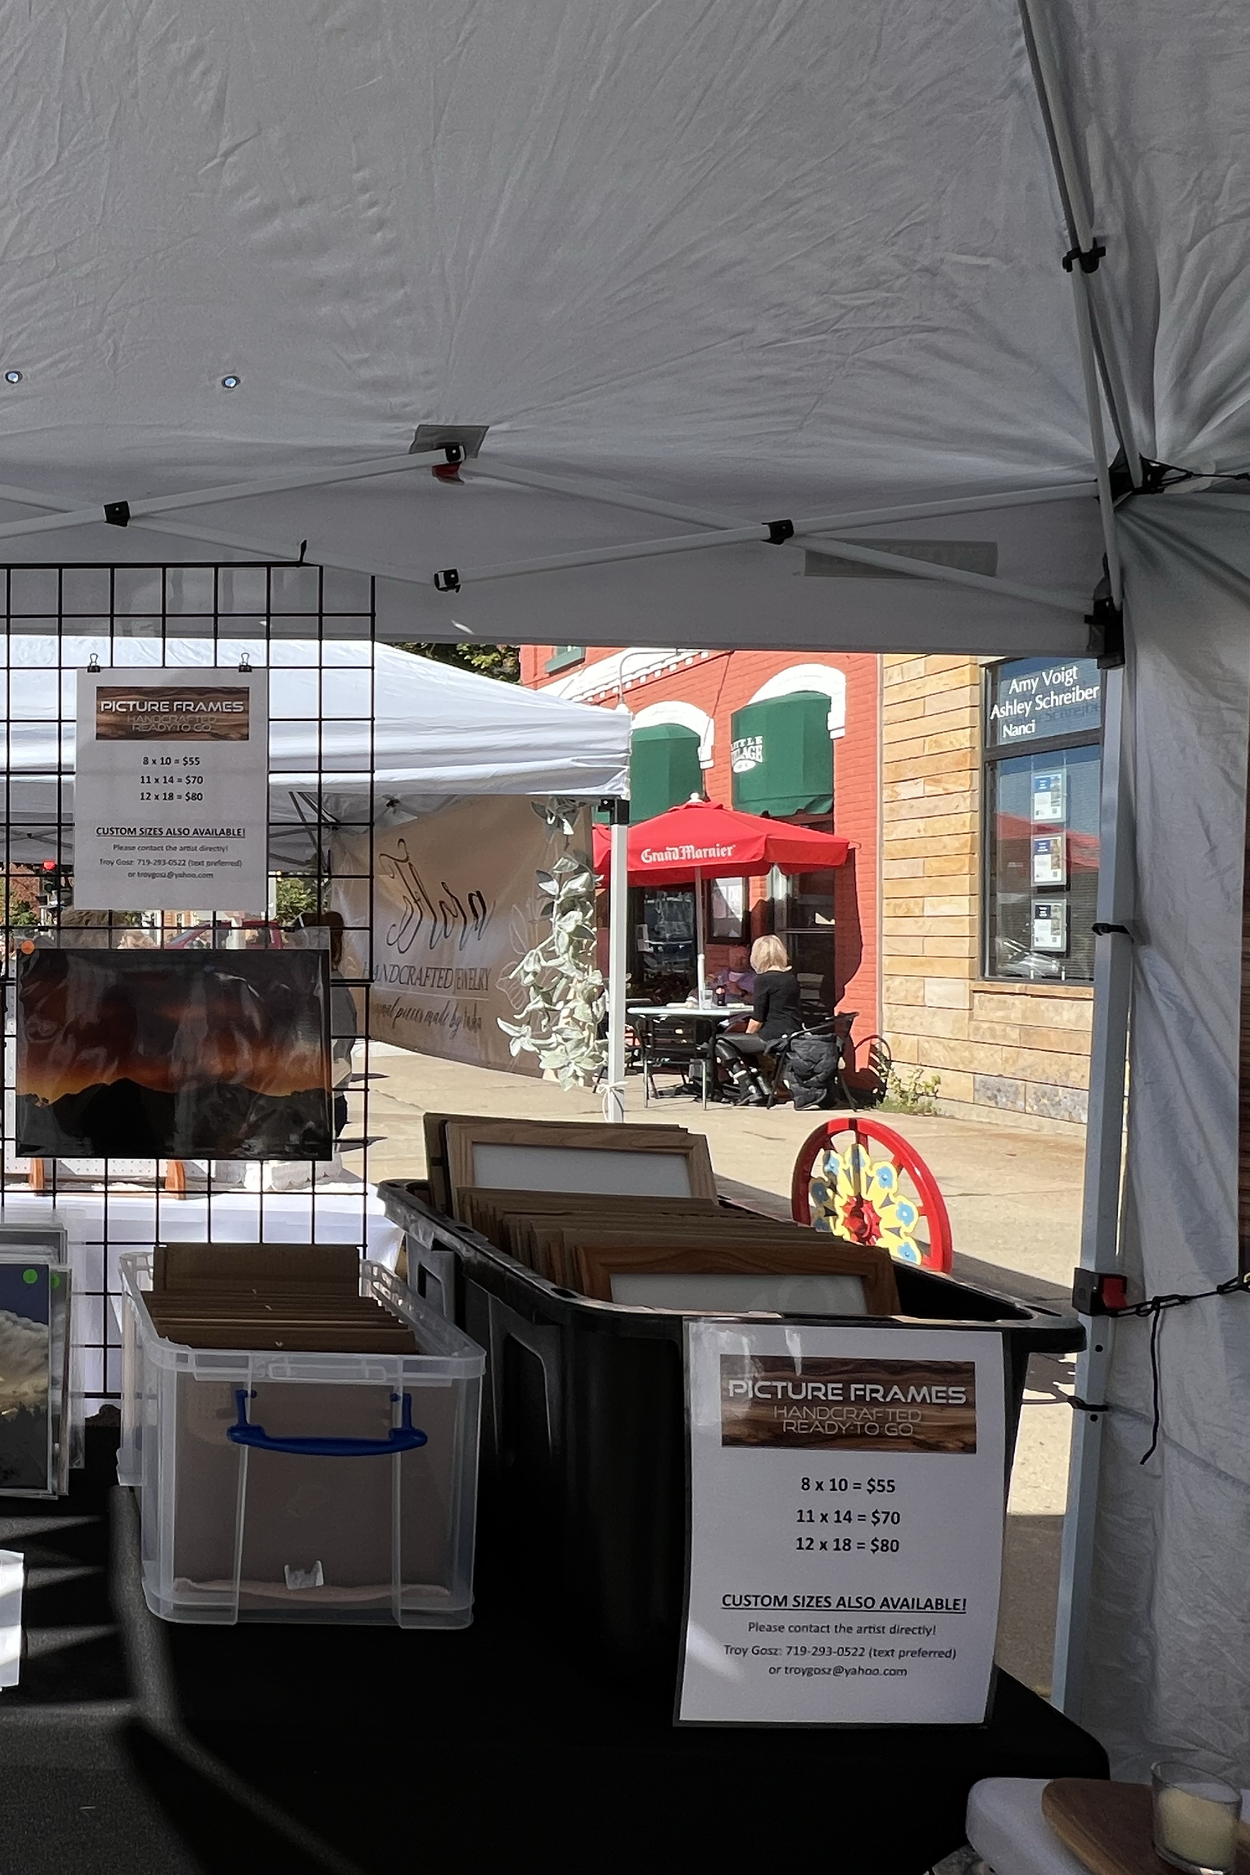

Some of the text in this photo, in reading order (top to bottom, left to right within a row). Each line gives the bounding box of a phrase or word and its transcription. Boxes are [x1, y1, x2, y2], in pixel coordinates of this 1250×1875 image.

[1009, 665, 1079, 695] Amy Voigt
[100, 701, 244, 712] PICTURE FRAMES
[990, 685, 1100, 720] Ashley Schreiber
[127, 714, 217, 724] HANDCRAFTED
[1002, 719, 1036, 738] Nanci
[142, 756, 149, 765] 8
[160, 756, 172, 765] 10
[182, 756, 200, 767] $55
[140, 776, 151, 784] 11
[162, 776, 174, 784] 14
[185, 775, 204, 785] $70
[140, 792, 151, 801] 12
[162, 792, 174, 801] 18
[185, 792, 204, 802] $80
[96, 827, 246, 837] CUSTOM SIZES ALSO AVAILABLE!
[137, 844, 164, 852] contact
[165, 844, 178, 852] the
[178, 844, 198, 852] artist
[640, 843, 734, 863] Grand Marnier
[99, 858, 114, 866] Troy
[137, 858, 186, 867] 719-293-0522
[728, 1379, 967, 1405] PICTURE FRAMES
[773, 1405, 922, 1423] HANDCRAFTED
[801, 1477, 896, 1495] 8 x 10 = $55
[796, 1509, 901, 1527] 11 x 14 = $70
[796, 1536, 900, 1555] 12 x 18 = $80
[721, 1593, 967, 1612] CUSTOM SIZES ALSO AVAILABLE!
[748, 1621, 937, 1637] Please contact the artist directly!
[724, 1644, 748, 1657] Troy
[785, 1645, 866, 1658] 719-293-0522
[868, 1646, 895, 1659] (text
[898, 1646, 957, 1660] preferred)
[768, 1664, 908, 1678] or troygosz@yahoo.com
